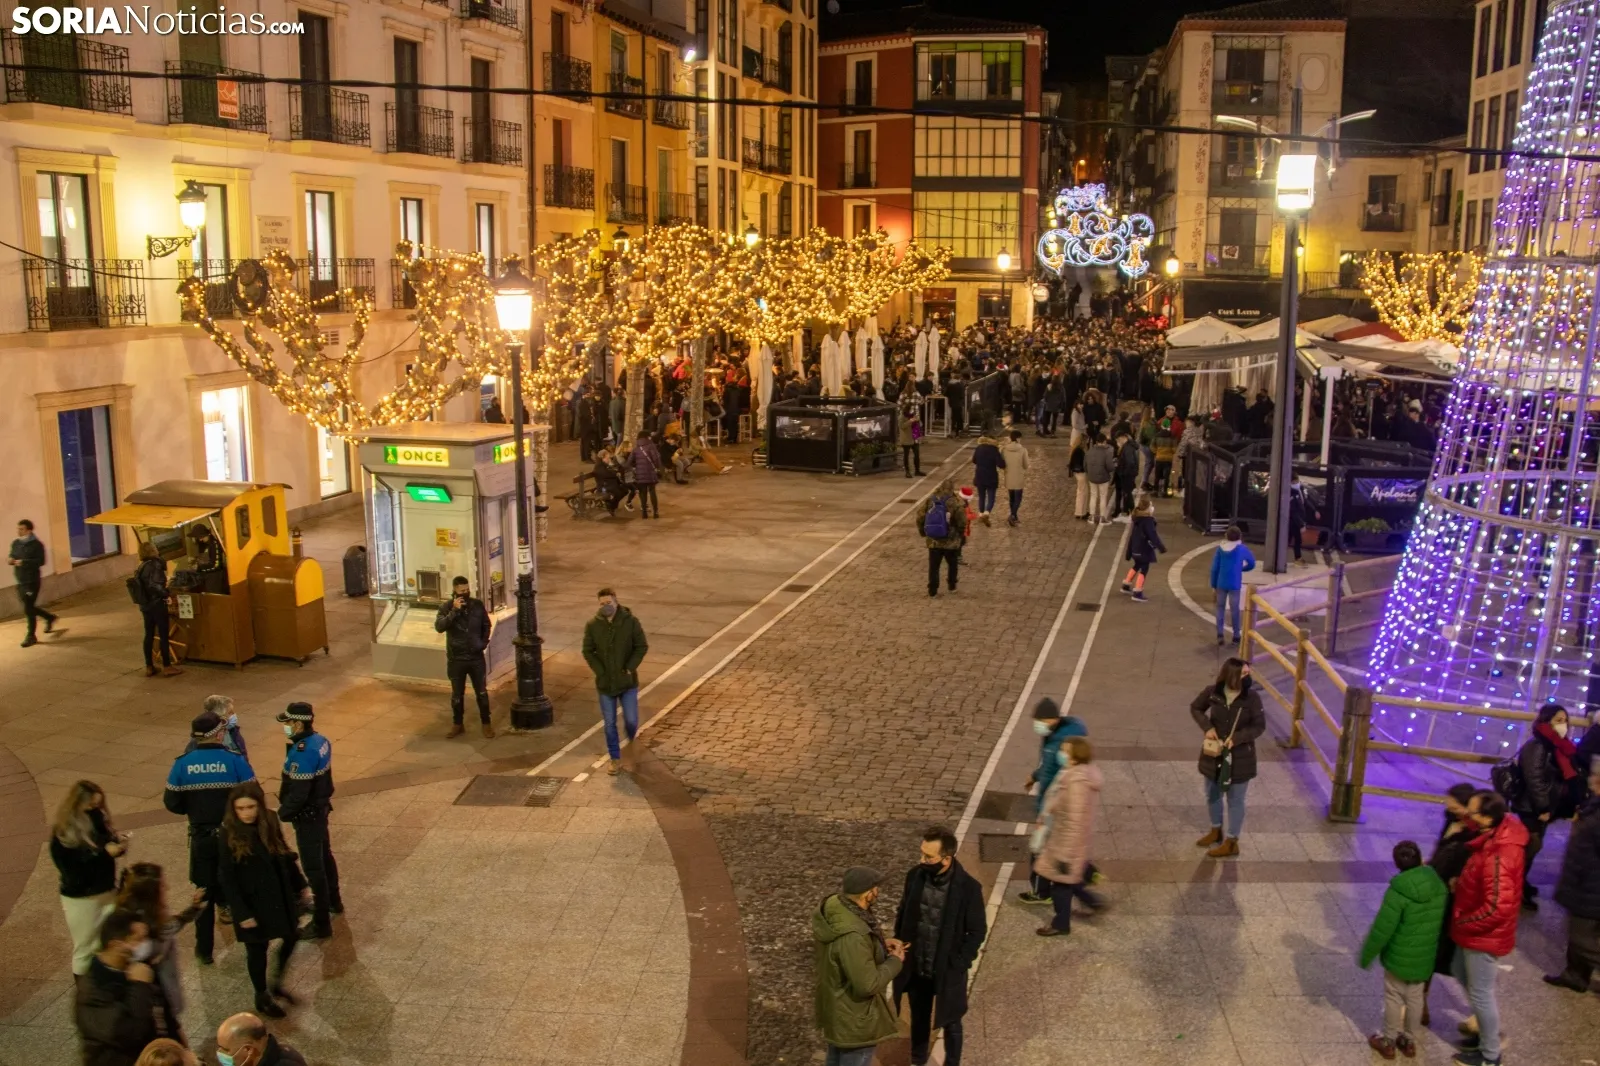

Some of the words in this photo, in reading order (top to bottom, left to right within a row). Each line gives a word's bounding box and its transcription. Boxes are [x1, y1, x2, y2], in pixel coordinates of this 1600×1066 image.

[403, 450, 443, 463] ONCE
[1371, 485, 1417, 502] Apolonia
[187, 760, 227, 775] POLICÍA
